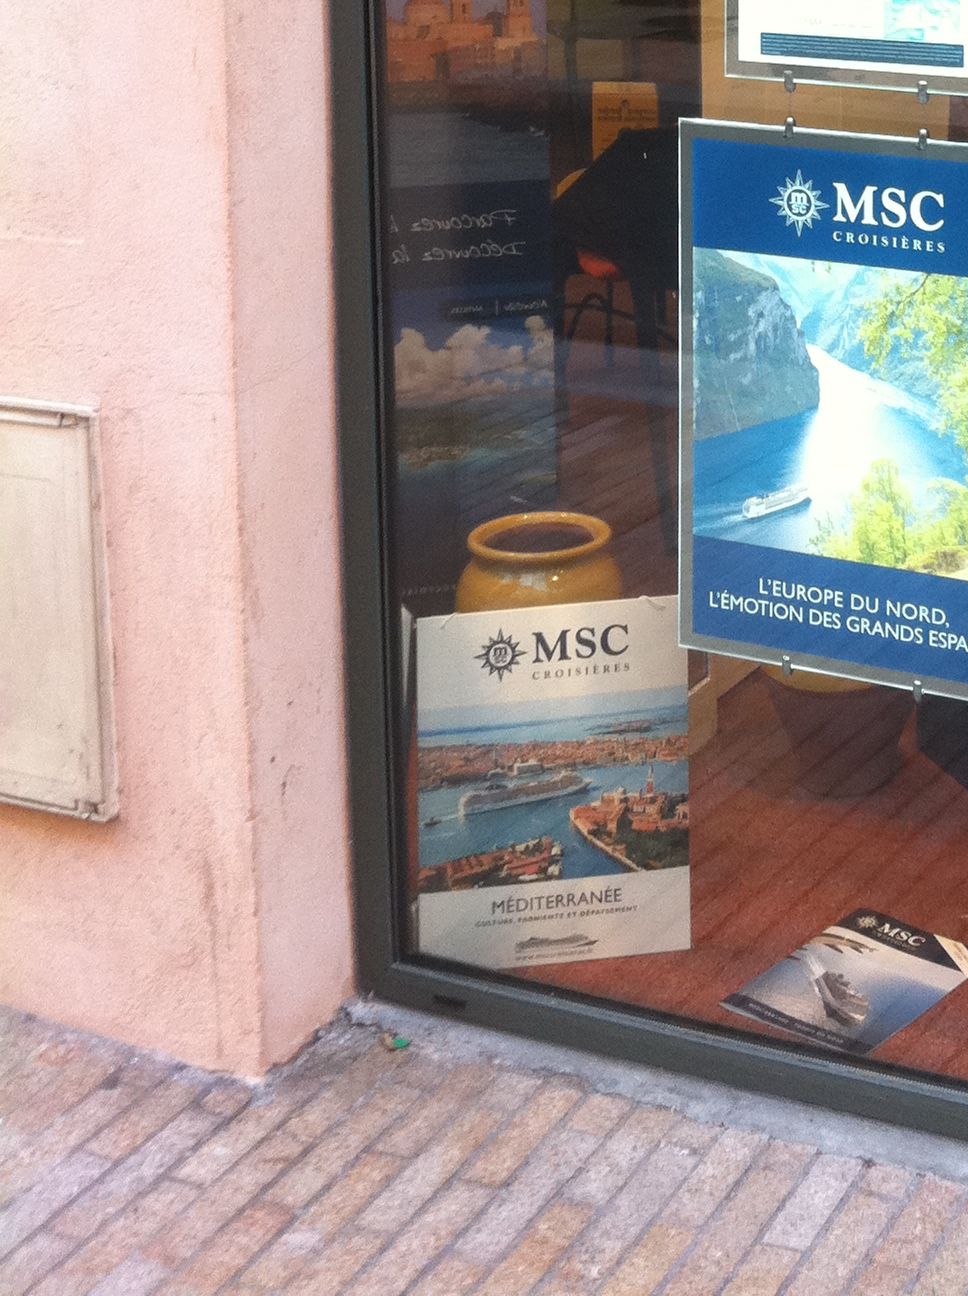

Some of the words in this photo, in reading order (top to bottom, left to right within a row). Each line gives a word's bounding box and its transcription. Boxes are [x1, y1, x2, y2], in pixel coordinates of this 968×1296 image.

[832, 182, 945, 232] MSC
[832, 230, 945, 253] CROISIÈRES
[709, 589, 803, 623] L'ÉMOTION
[809, 608, 841, 630] DES
[846, 616, 923, 645] GRANDS
[759, 577, 843, 607] L'EUROPE
[850, 593, 880, 613] DU
[886, 600, 950, 629] NORD,
[532, 624, 630, 664] MSC
[532, 661, 631, 681] CROISIÈRES
[491, 885, 623, 915] MÉDITERRANÉE
[878, 922, 927, 947] MSC
